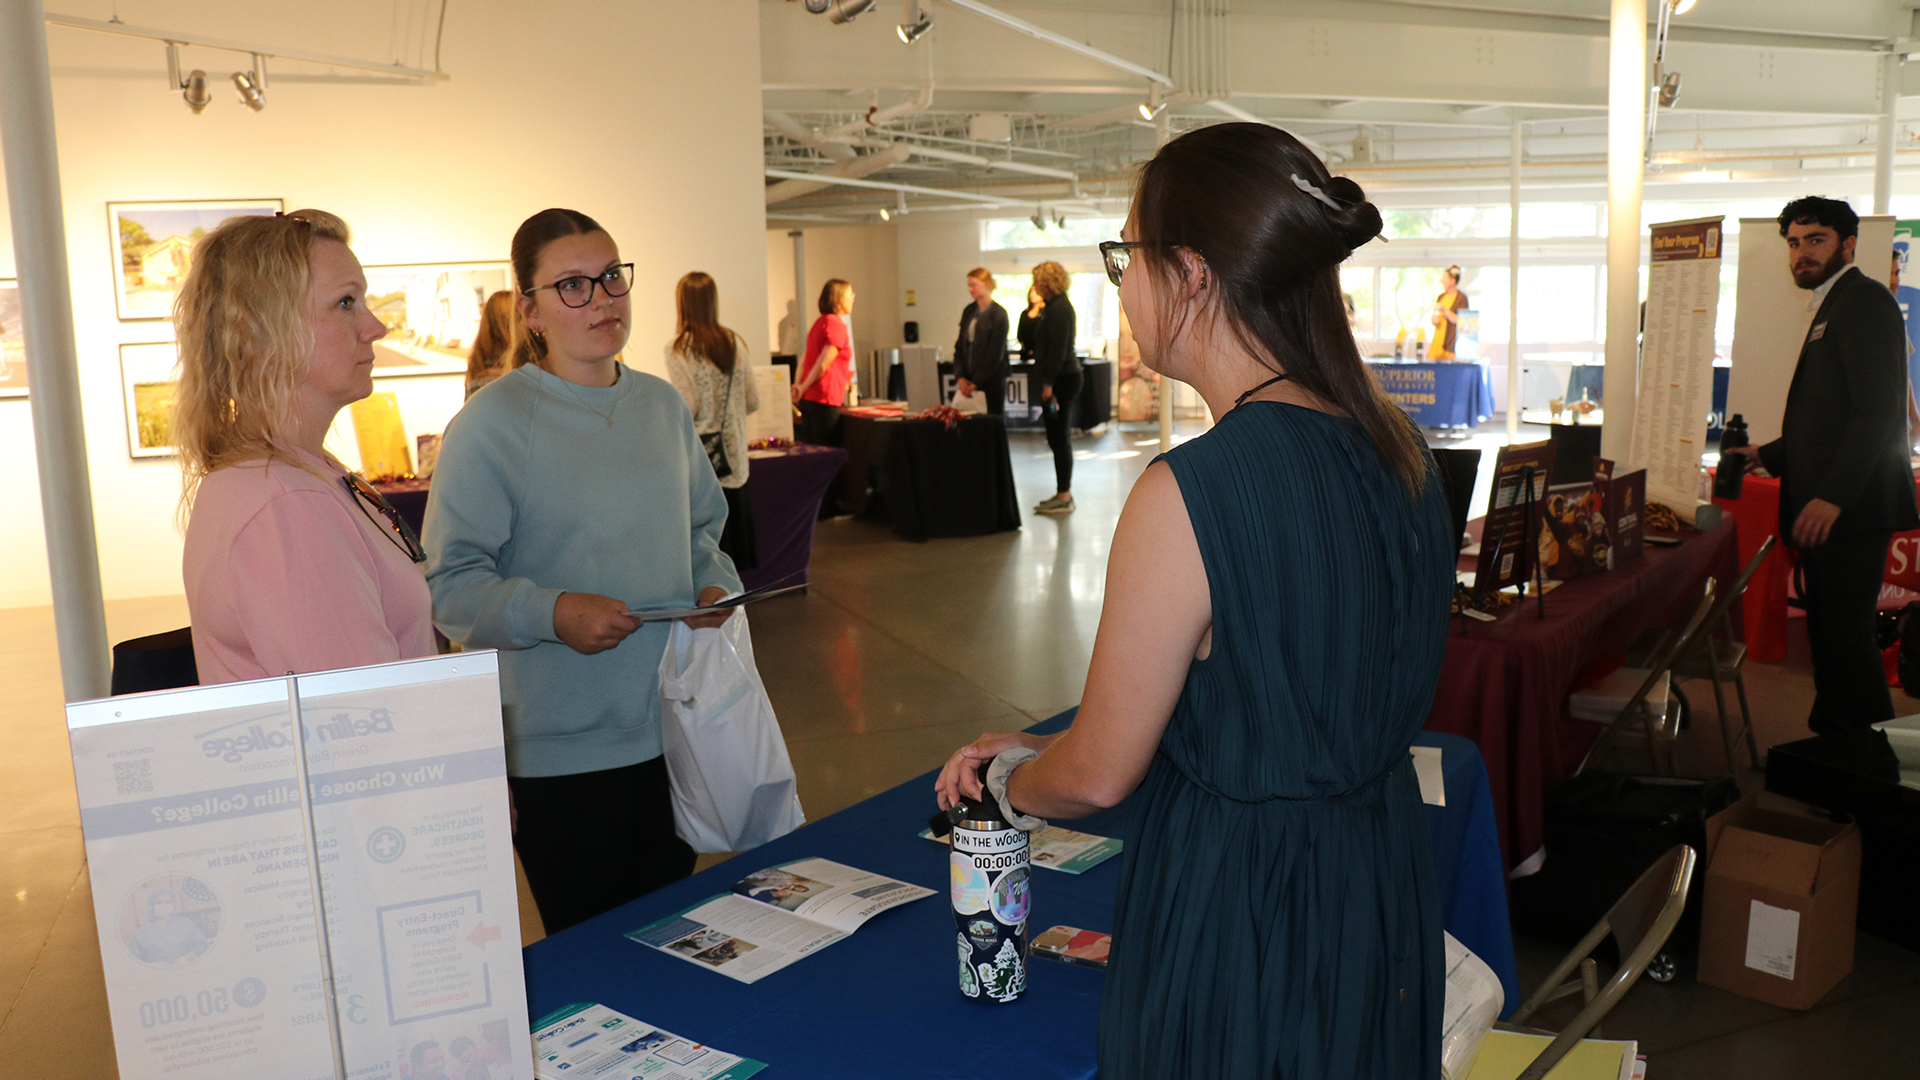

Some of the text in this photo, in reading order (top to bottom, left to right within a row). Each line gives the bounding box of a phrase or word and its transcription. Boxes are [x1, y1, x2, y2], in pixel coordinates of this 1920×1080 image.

[1387, 393, 1436, 405] ENTERS
[961, 831, 1027, 848] IN THE WOODS
